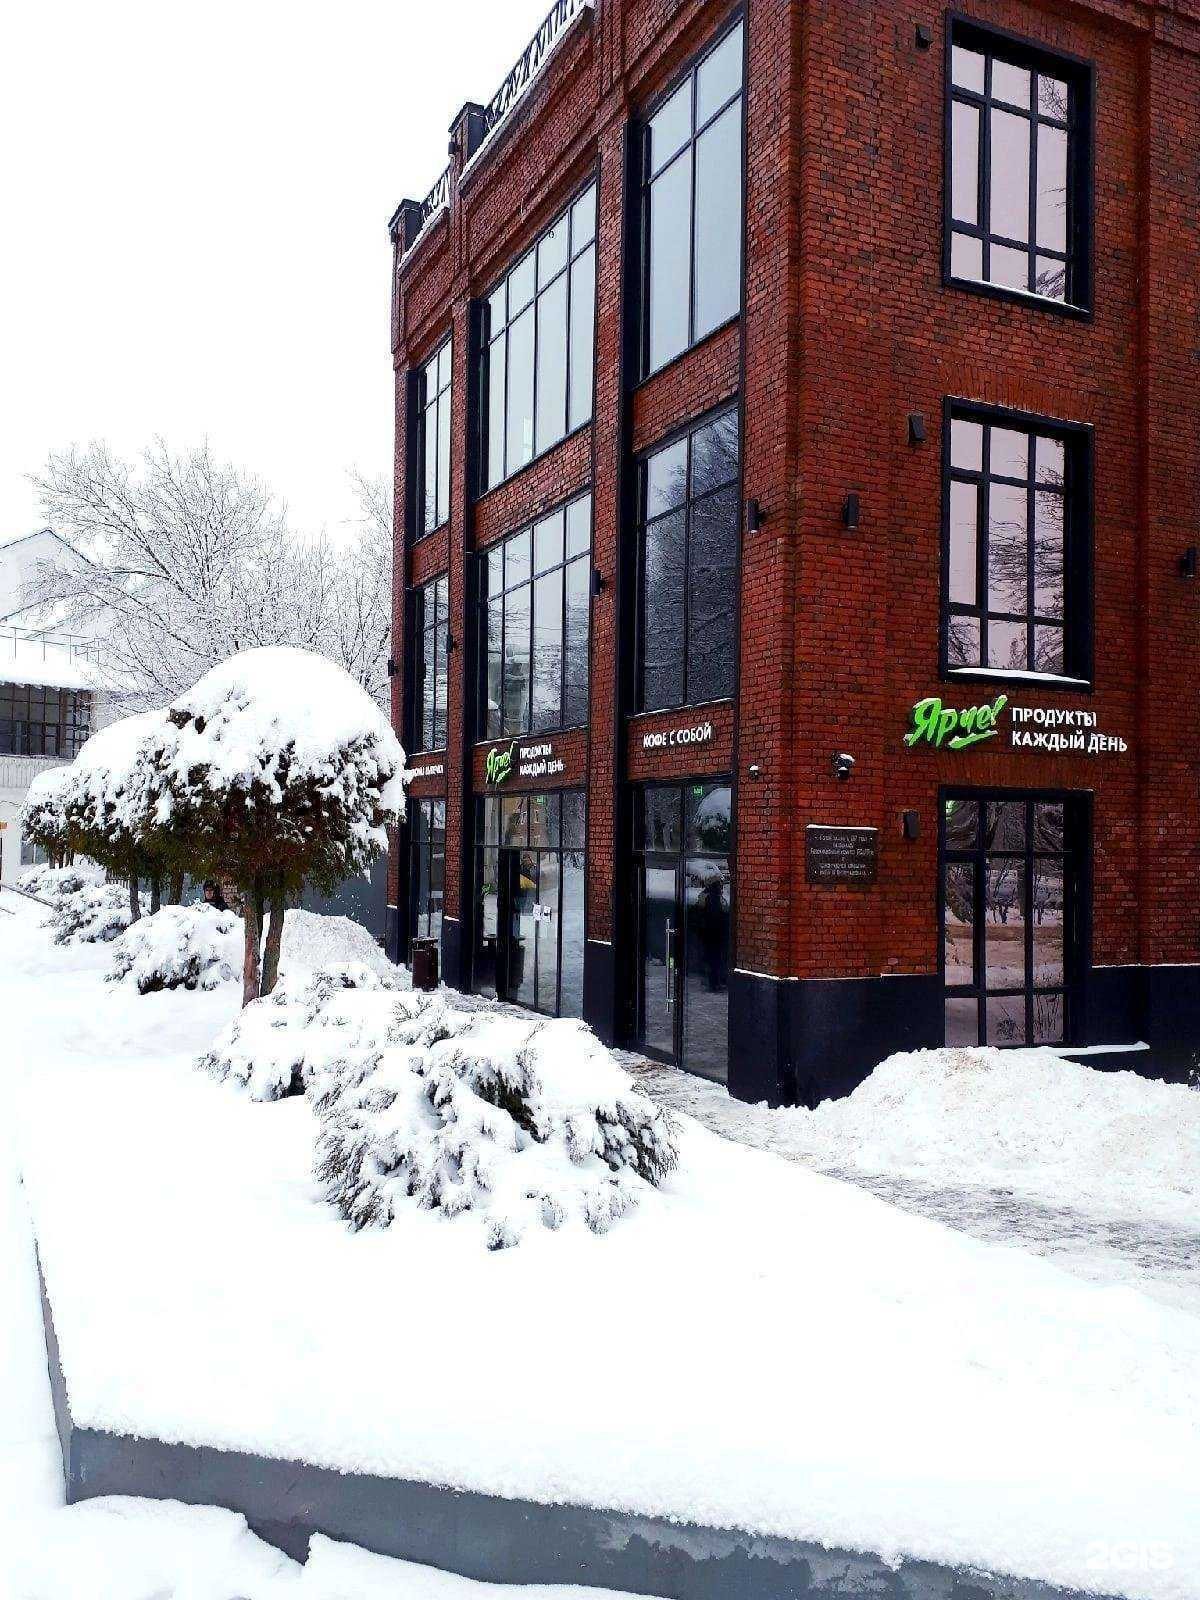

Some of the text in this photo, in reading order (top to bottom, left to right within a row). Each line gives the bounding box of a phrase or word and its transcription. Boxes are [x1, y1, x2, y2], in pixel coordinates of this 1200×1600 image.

[1011, 707, 1098, 727] ПРОДУКТЫ
[642, 721, 712, 749] КОФЕ С СОБОЙ
[1012, 729, 1128, 753] КАЖДЫЙ ДЕНЬ
[519, 744, 552, 760] ПРОДУКТЫ
[519, 759, 564, 776] КАЖДЫЙ ДЕНЬ
